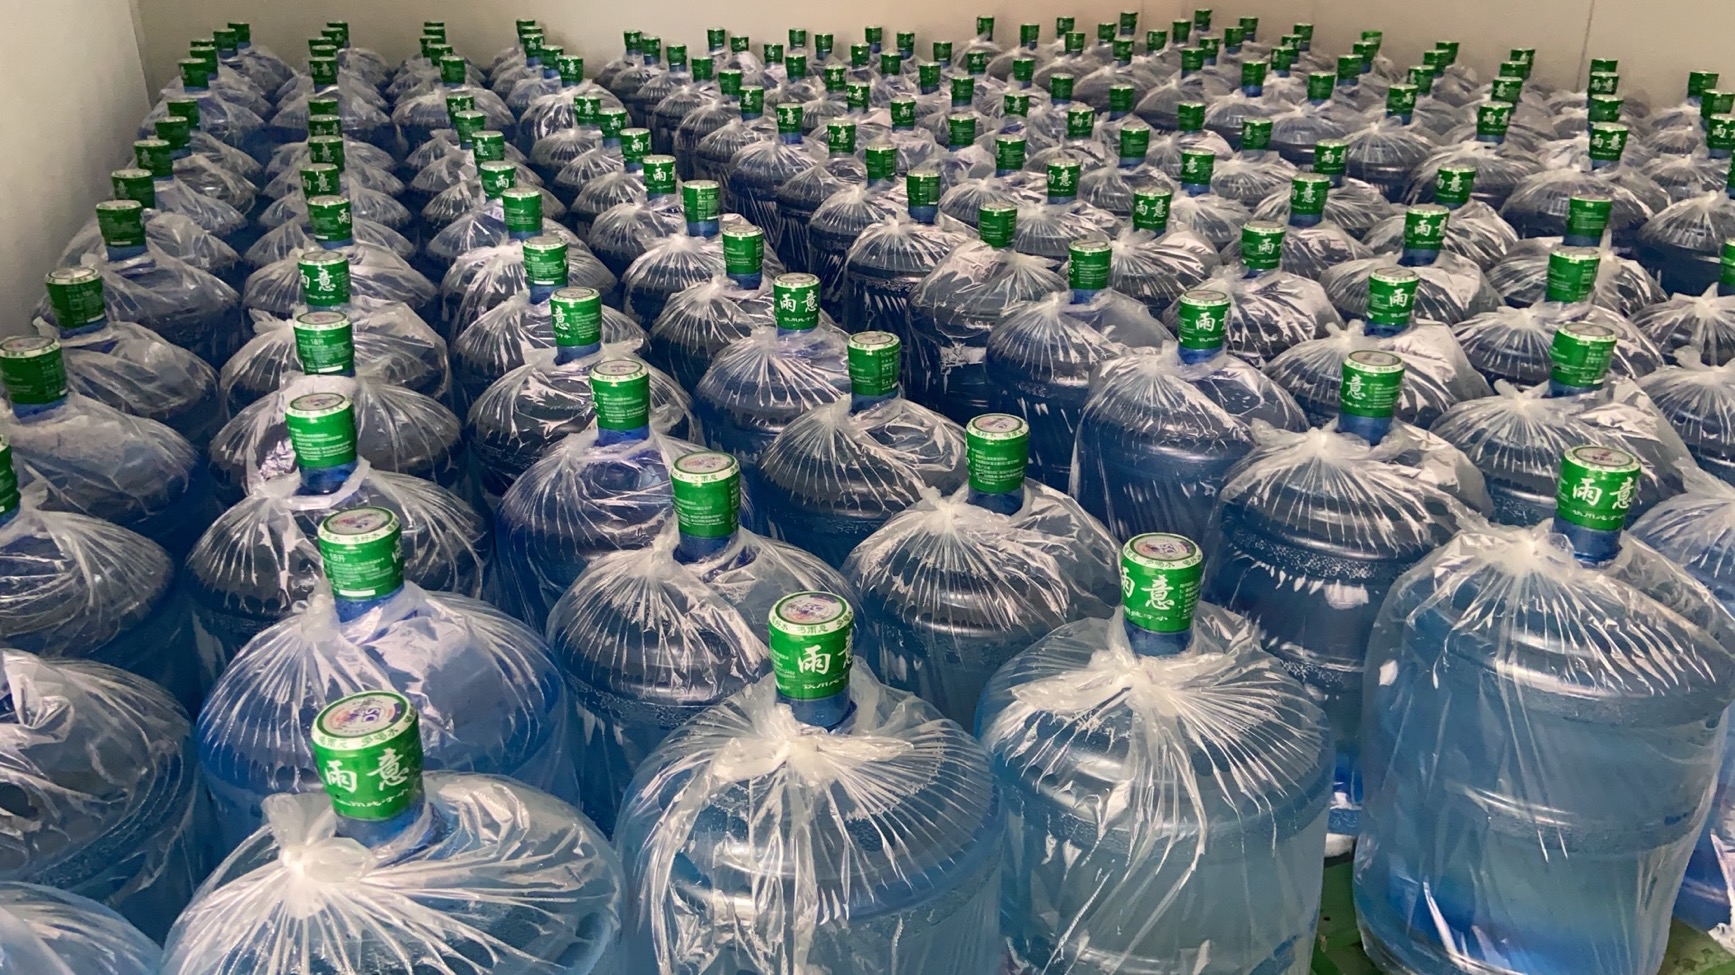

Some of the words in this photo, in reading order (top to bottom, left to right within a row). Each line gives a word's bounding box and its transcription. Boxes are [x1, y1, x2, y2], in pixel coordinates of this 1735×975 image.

[781, 290, 817, 312] 雨意
[1573, 477, 1634, 509] 雨意
[325, 748, 409, 793] 雨意
